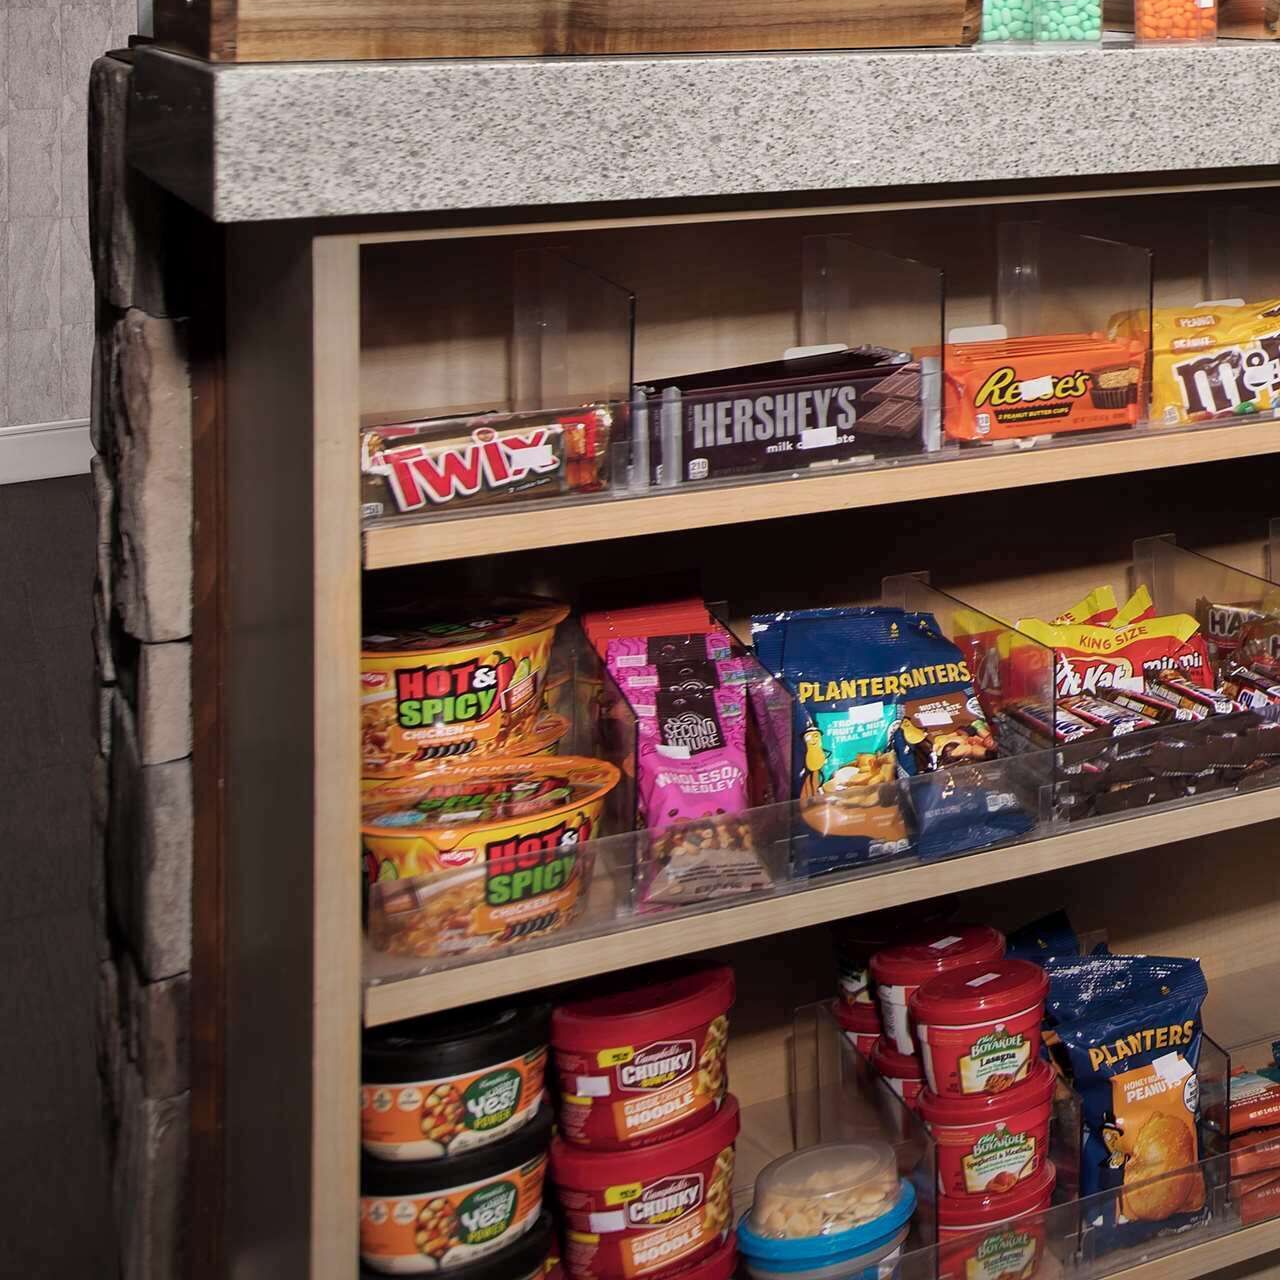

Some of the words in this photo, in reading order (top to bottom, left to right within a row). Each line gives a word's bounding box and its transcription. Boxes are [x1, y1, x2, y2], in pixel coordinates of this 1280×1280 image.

[694, 386, 857, 449] HERSHEY'S
[766, 441, 793, 454] milk
[1079, 634, 1111, 650] KING
[1116, 625, 1149, 648] SIZE
[399, 665, 472, 701] HOT
[474, 667, 496, 689] &
[399, 691, 494, 728] SPICY
[402, 724, 464, 741] CHICKEN
[663, 718, 717, 742] SECOND
[680, 780, 735, 794] MEDLEY
[486, 856, 576, 906] SPICY
[979, 1052, 1016, 1068] Lasagna
[1088, 1020, 1196, 1072] PLANTERS
[622, 1052, 691, 1083] CHUNKY
[624, 1090, 695, 1128] NOODLE
[629, 1184, 700, 1222] CHUNKY
